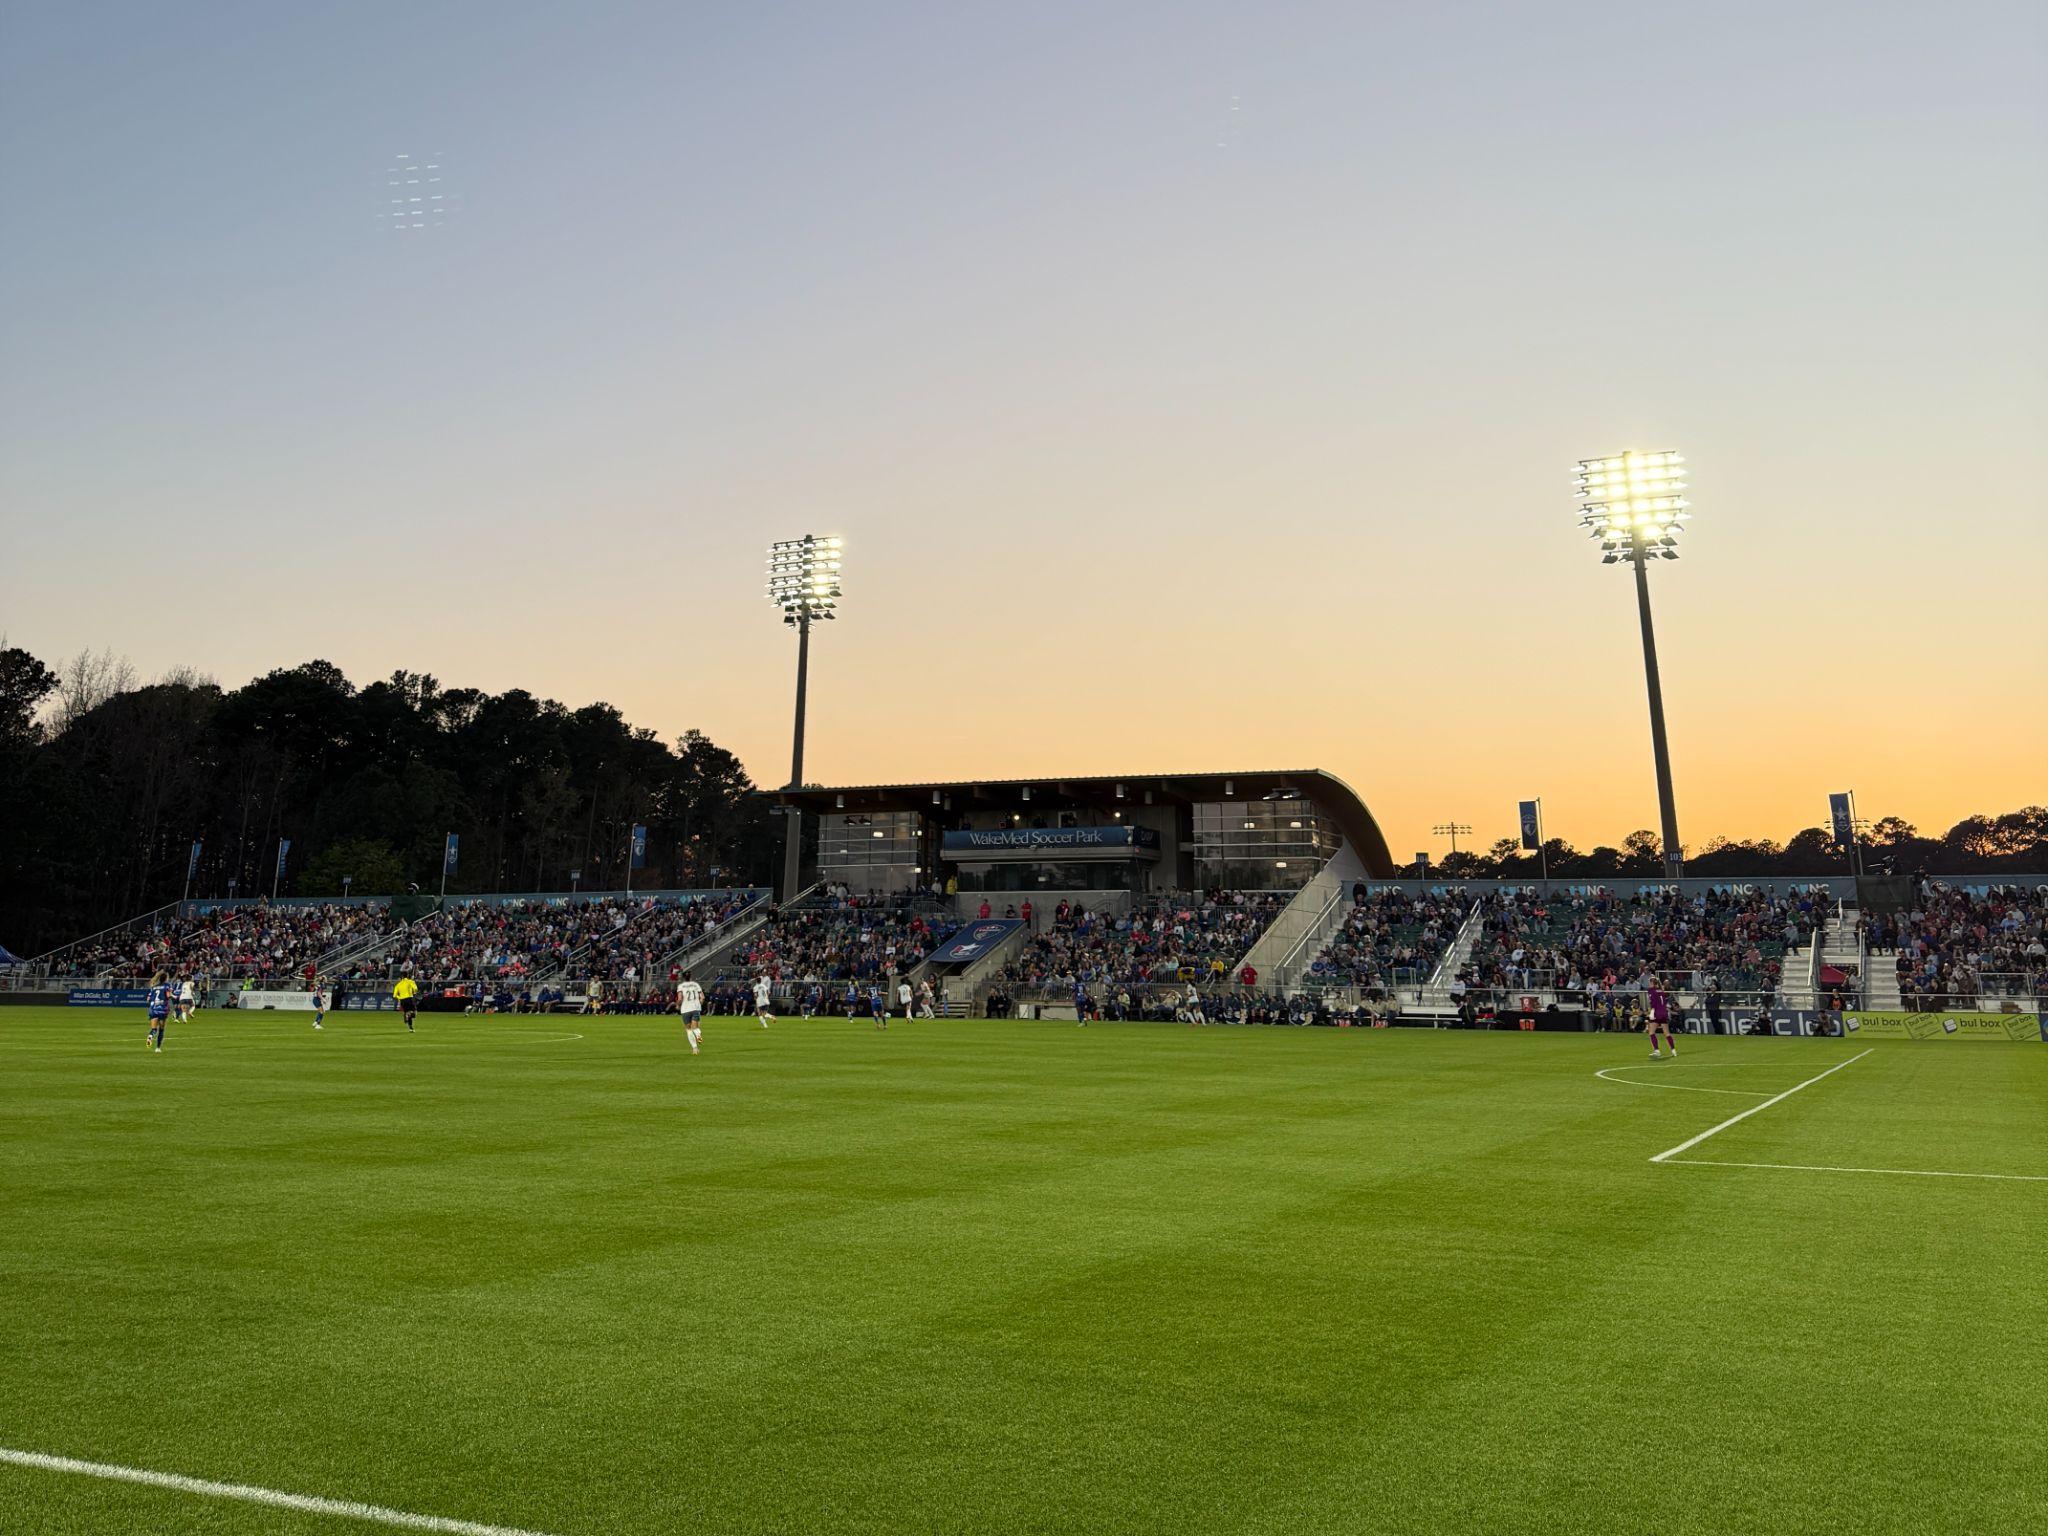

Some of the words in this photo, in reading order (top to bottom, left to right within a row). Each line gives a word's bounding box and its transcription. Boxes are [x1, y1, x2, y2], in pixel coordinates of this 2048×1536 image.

[969, 831, 1029, 845] WakeMed
[1031, 831, 1074, 844] Soccer
[1076, 829, 1102, 843] Park
[1658, 884, 1679, 895] NC
[1732, 883, 1753, 895] NC
[512, 898, 525, 907] NC
[556, 897, 569, 906] NC
[686, 990, 697, 1001] 21
[1862, 1017, 1879, 1026] bul
[1881, 1017, 1902, 1026] box
[1960, 1018, 1977, 1027] bul
[1979, 1018, 2001, 1027] box
